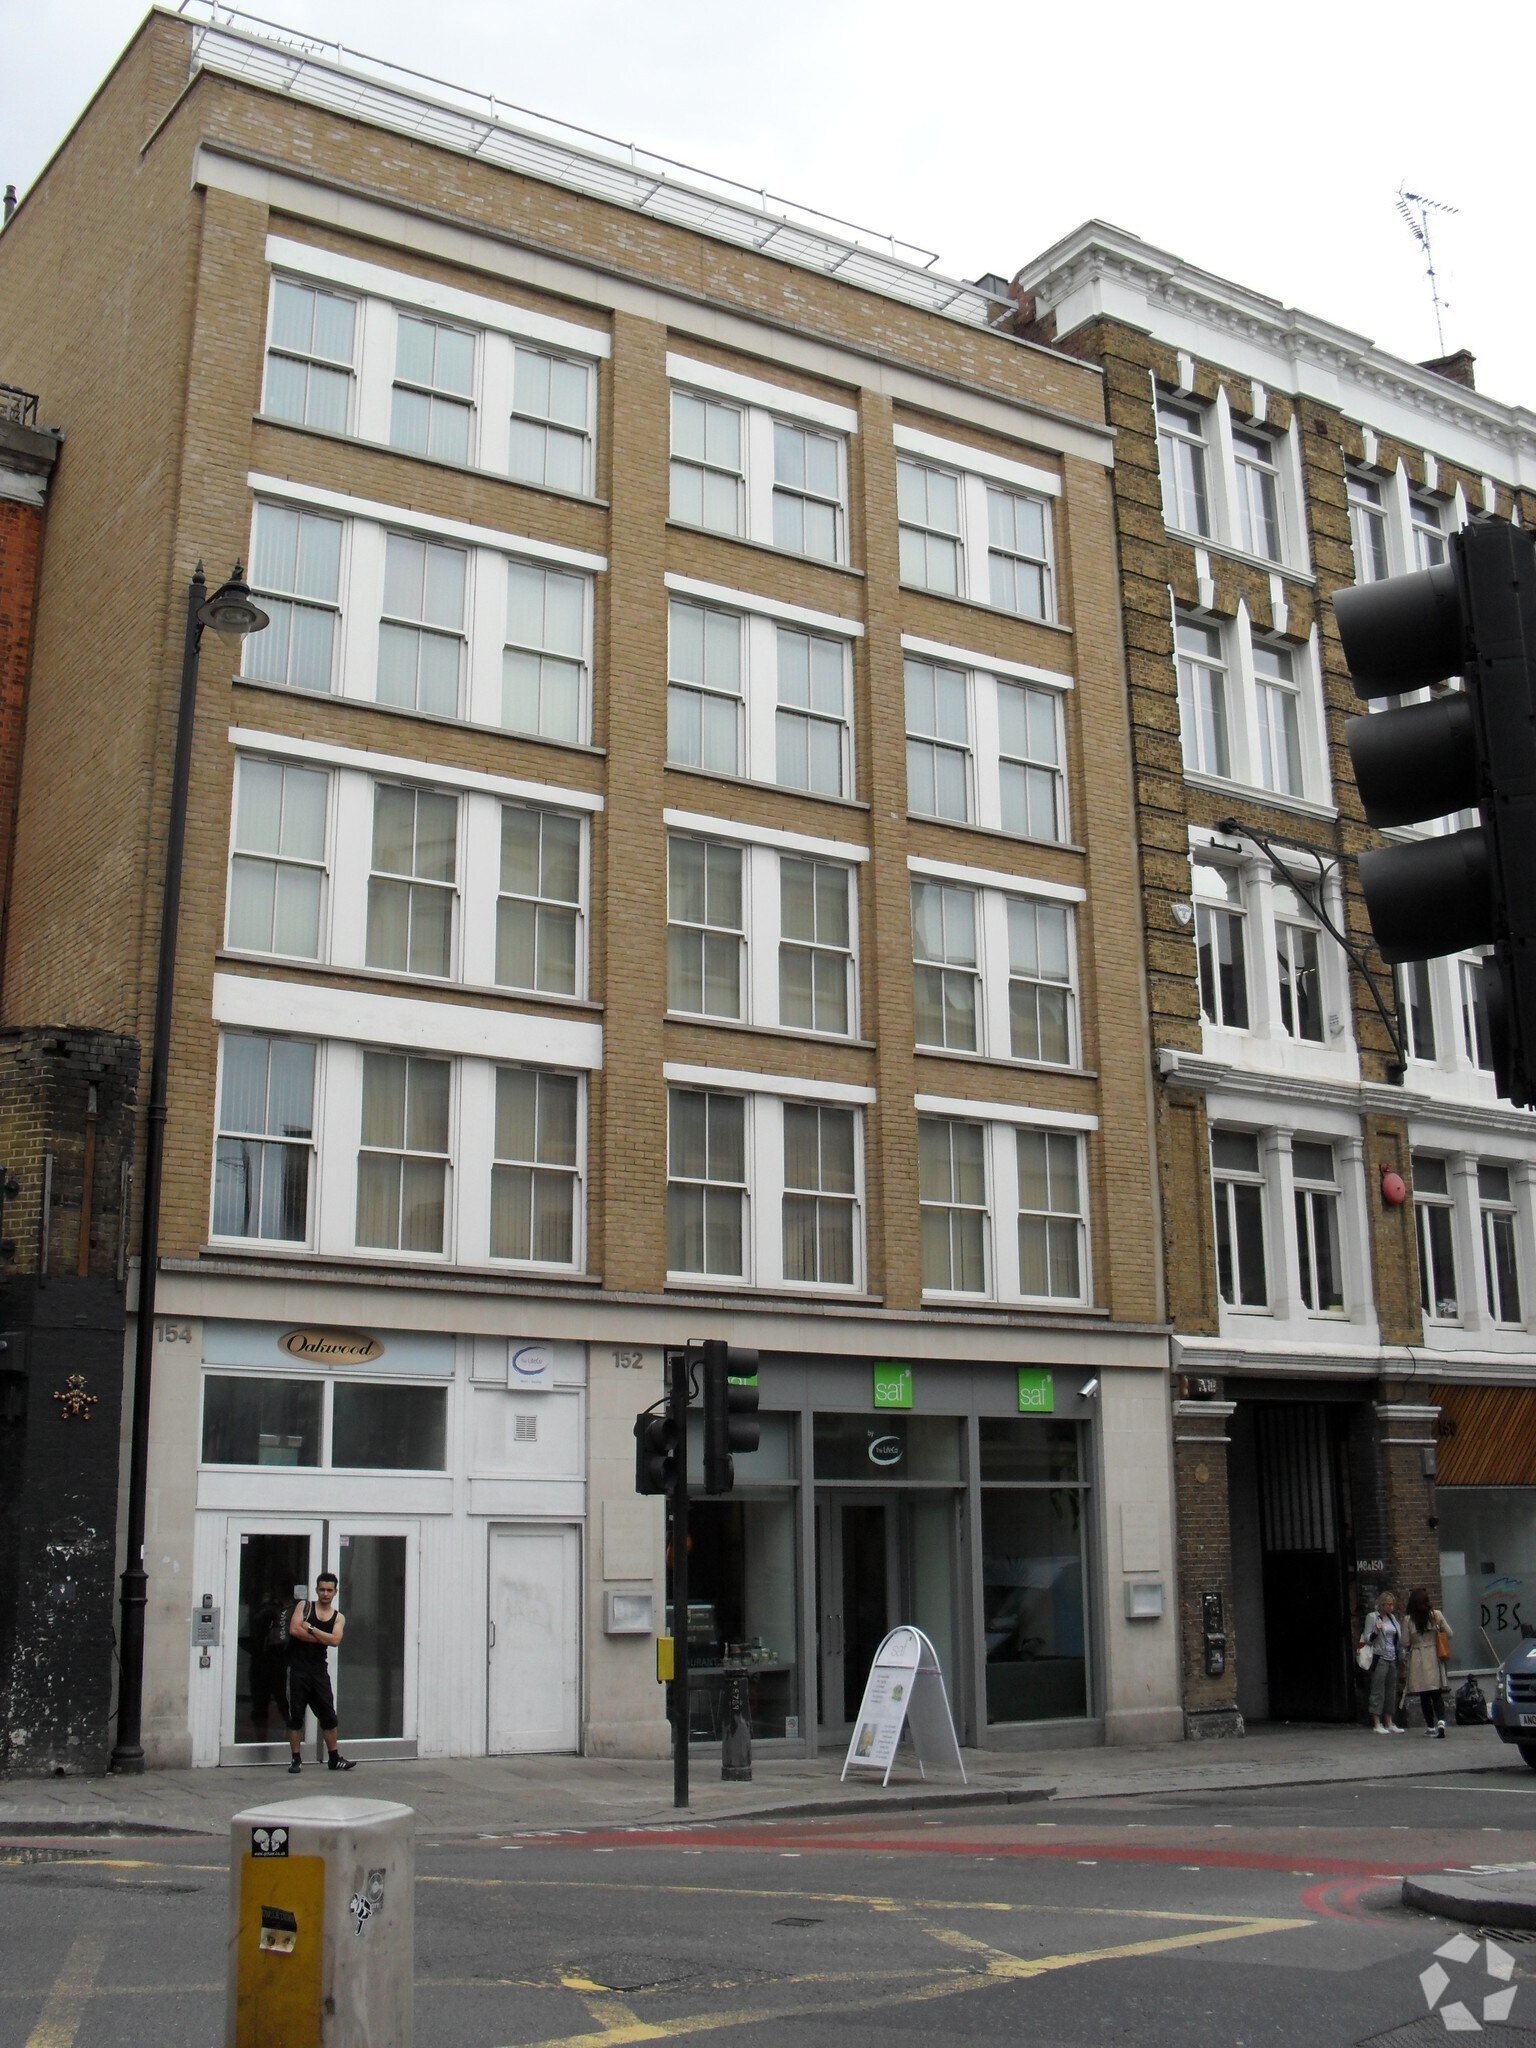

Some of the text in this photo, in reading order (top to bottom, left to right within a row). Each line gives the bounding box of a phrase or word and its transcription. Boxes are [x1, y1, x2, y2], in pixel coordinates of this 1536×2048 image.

[155, 1323, 194, 1344] 154
[286, 1333, 375, 1356] Oakwood
[611, 1351, 644, 1370] 152
[1480, 1602, 1521, 1632] DBS
